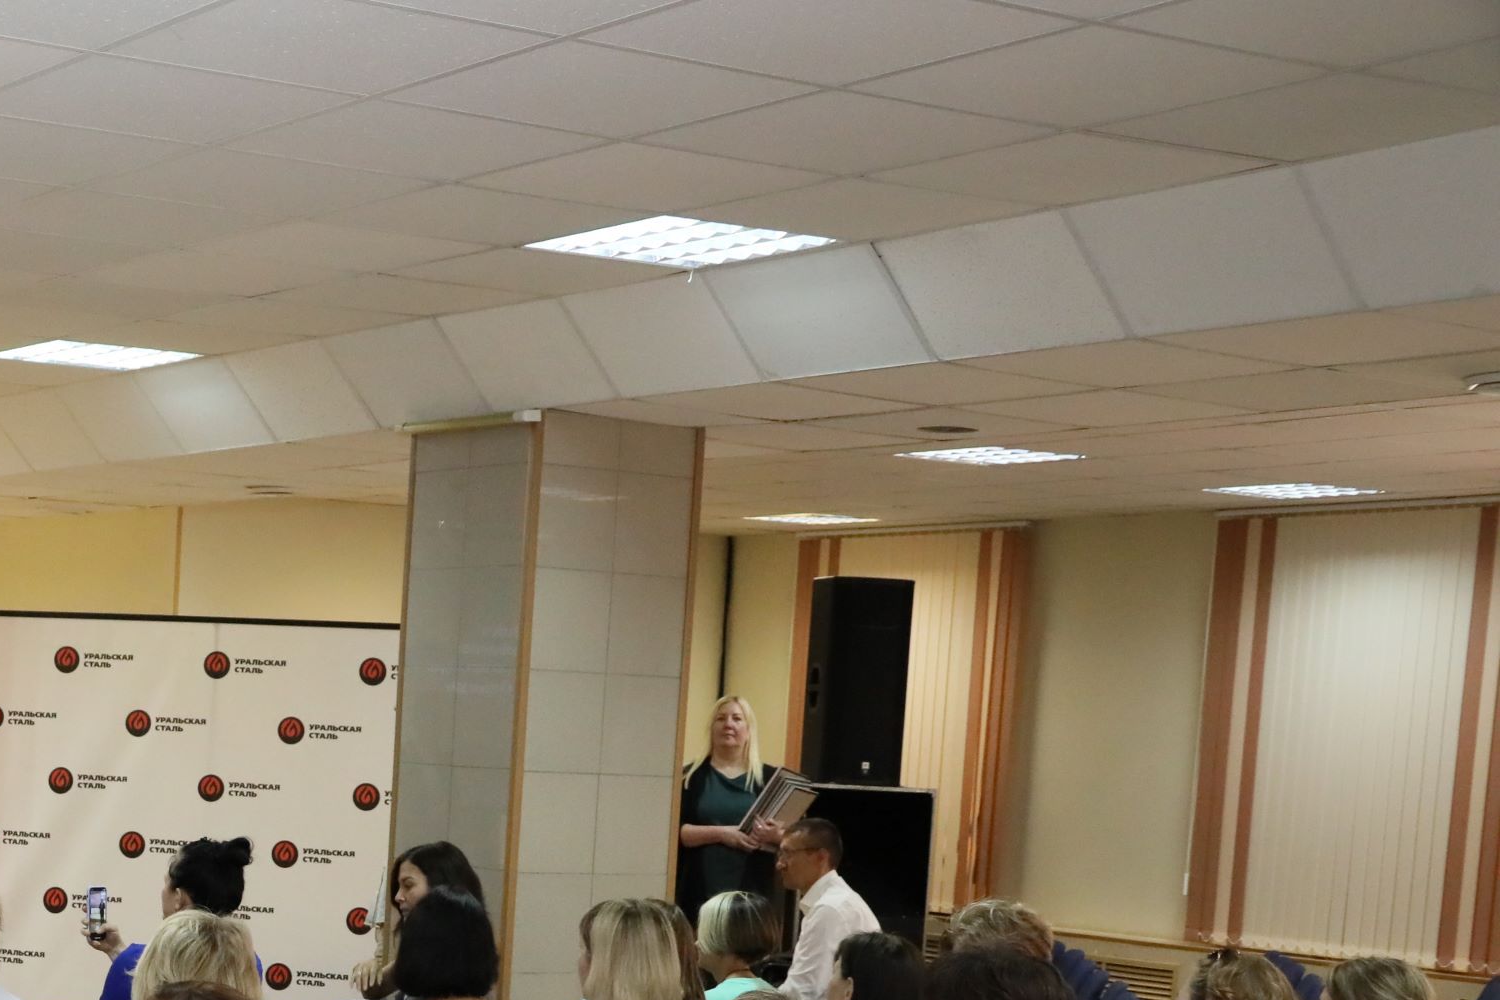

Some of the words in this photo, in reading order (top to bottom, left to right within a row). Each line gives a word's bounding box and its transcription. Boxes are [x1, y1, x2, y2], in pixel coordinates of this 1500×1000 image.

[84, 653, 133, 661] УРАЛЬСКАЯ
[235, 658, 286, 666] УРАЛЬСКАЯ
[8, 710, 57, 719] УРАЛЬСКАЯ
[155, 717, 206, 725] УРАЛЬСКАЯ
[309, 724, 361, 732] УРАЛЬСКАЯ
[309, 732, 338, 740] СТАЛЬ
[78, 774, 127, 782] УРАЛЬСКАЯ
[229, 782, 280, 790] УРАЛЬСКАЯ
[3, 830, 51, 838] УРАЛЬСКАЯ
[303, 848, 355, 857] УРАЛЬСКАЯ
[297, 971, 348, 980] УРАЛЬСКАЯ
